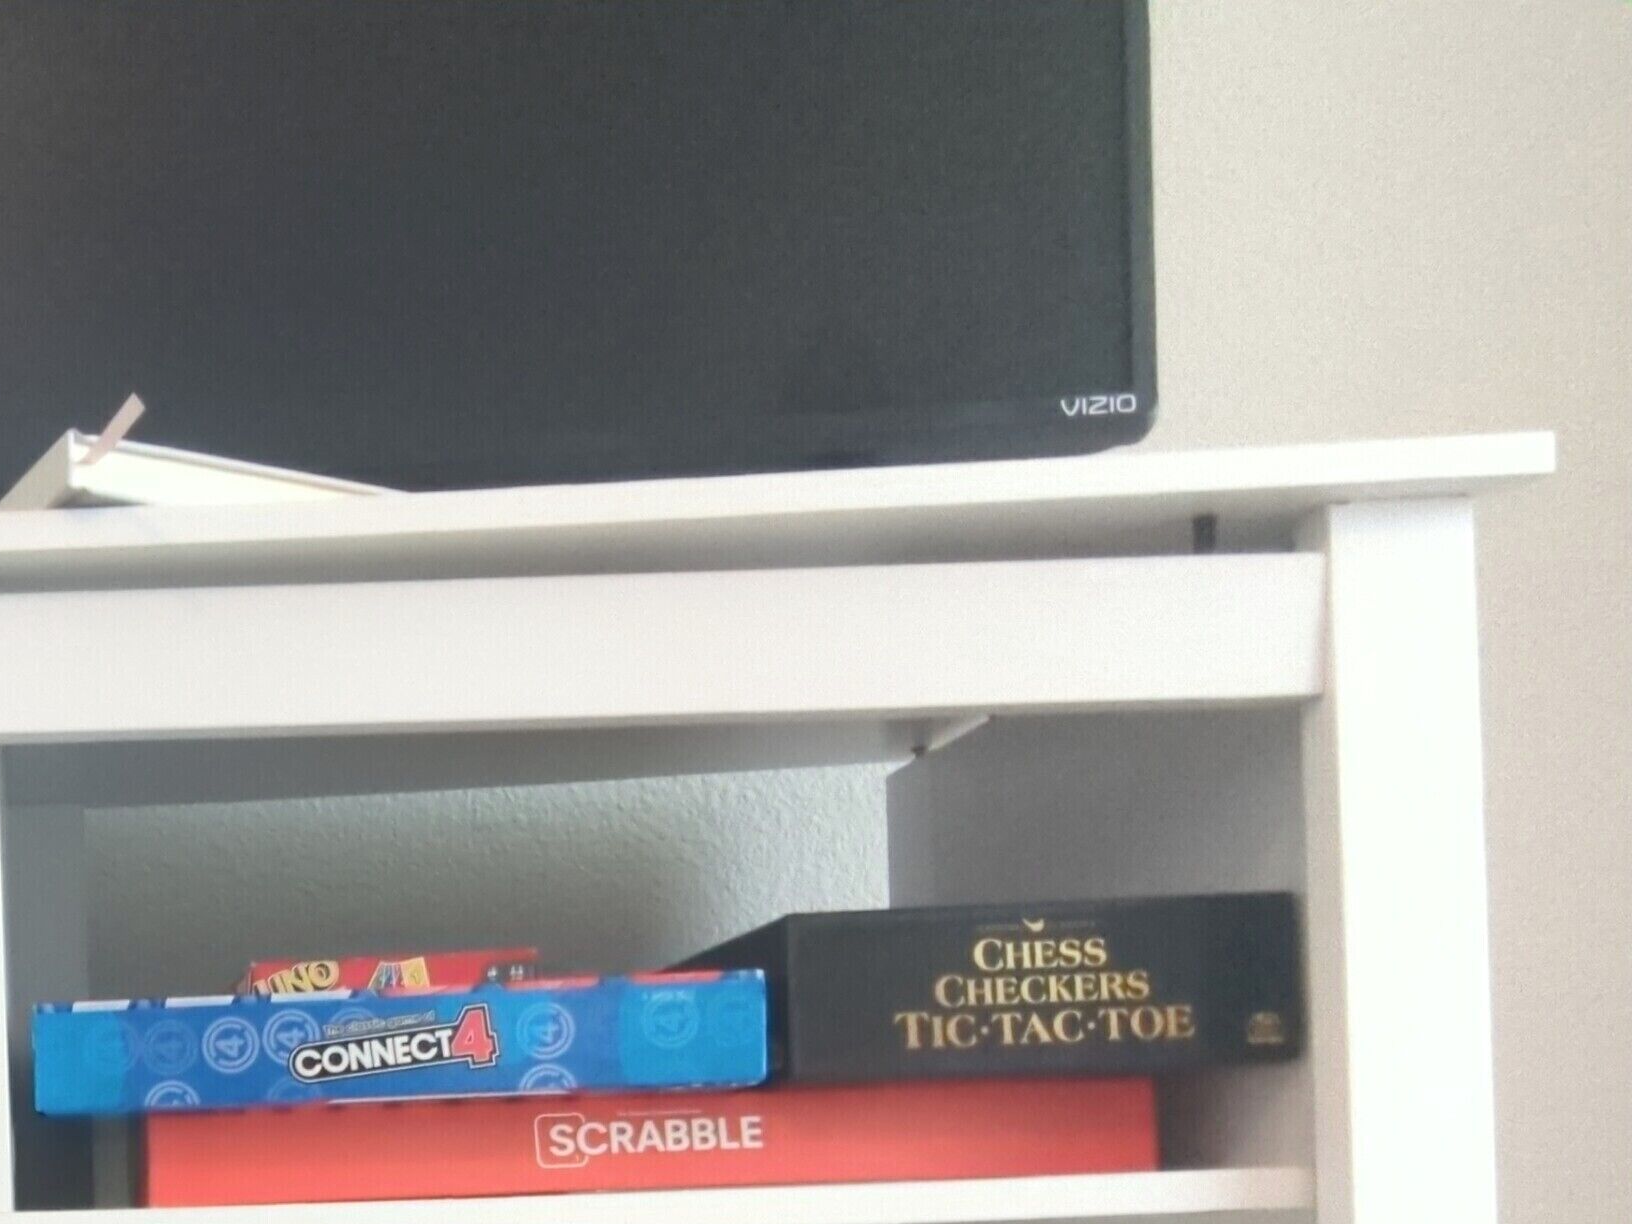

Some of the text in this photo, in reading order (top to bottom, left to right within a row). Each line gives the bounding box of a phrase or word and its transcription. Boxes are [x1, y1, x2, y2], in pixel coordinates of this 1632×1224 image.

[1060, 393, 1137, 416] VIZIO
[973, 938, 1107, 971] CHESS
[934, 971, 1150, 1008] CHECKERS
[294, 1028, 452, 1078] CONNECT
[451, 1008, 494, 1063] 4
[549, 1115, 764, 1157] SCRABBLE
